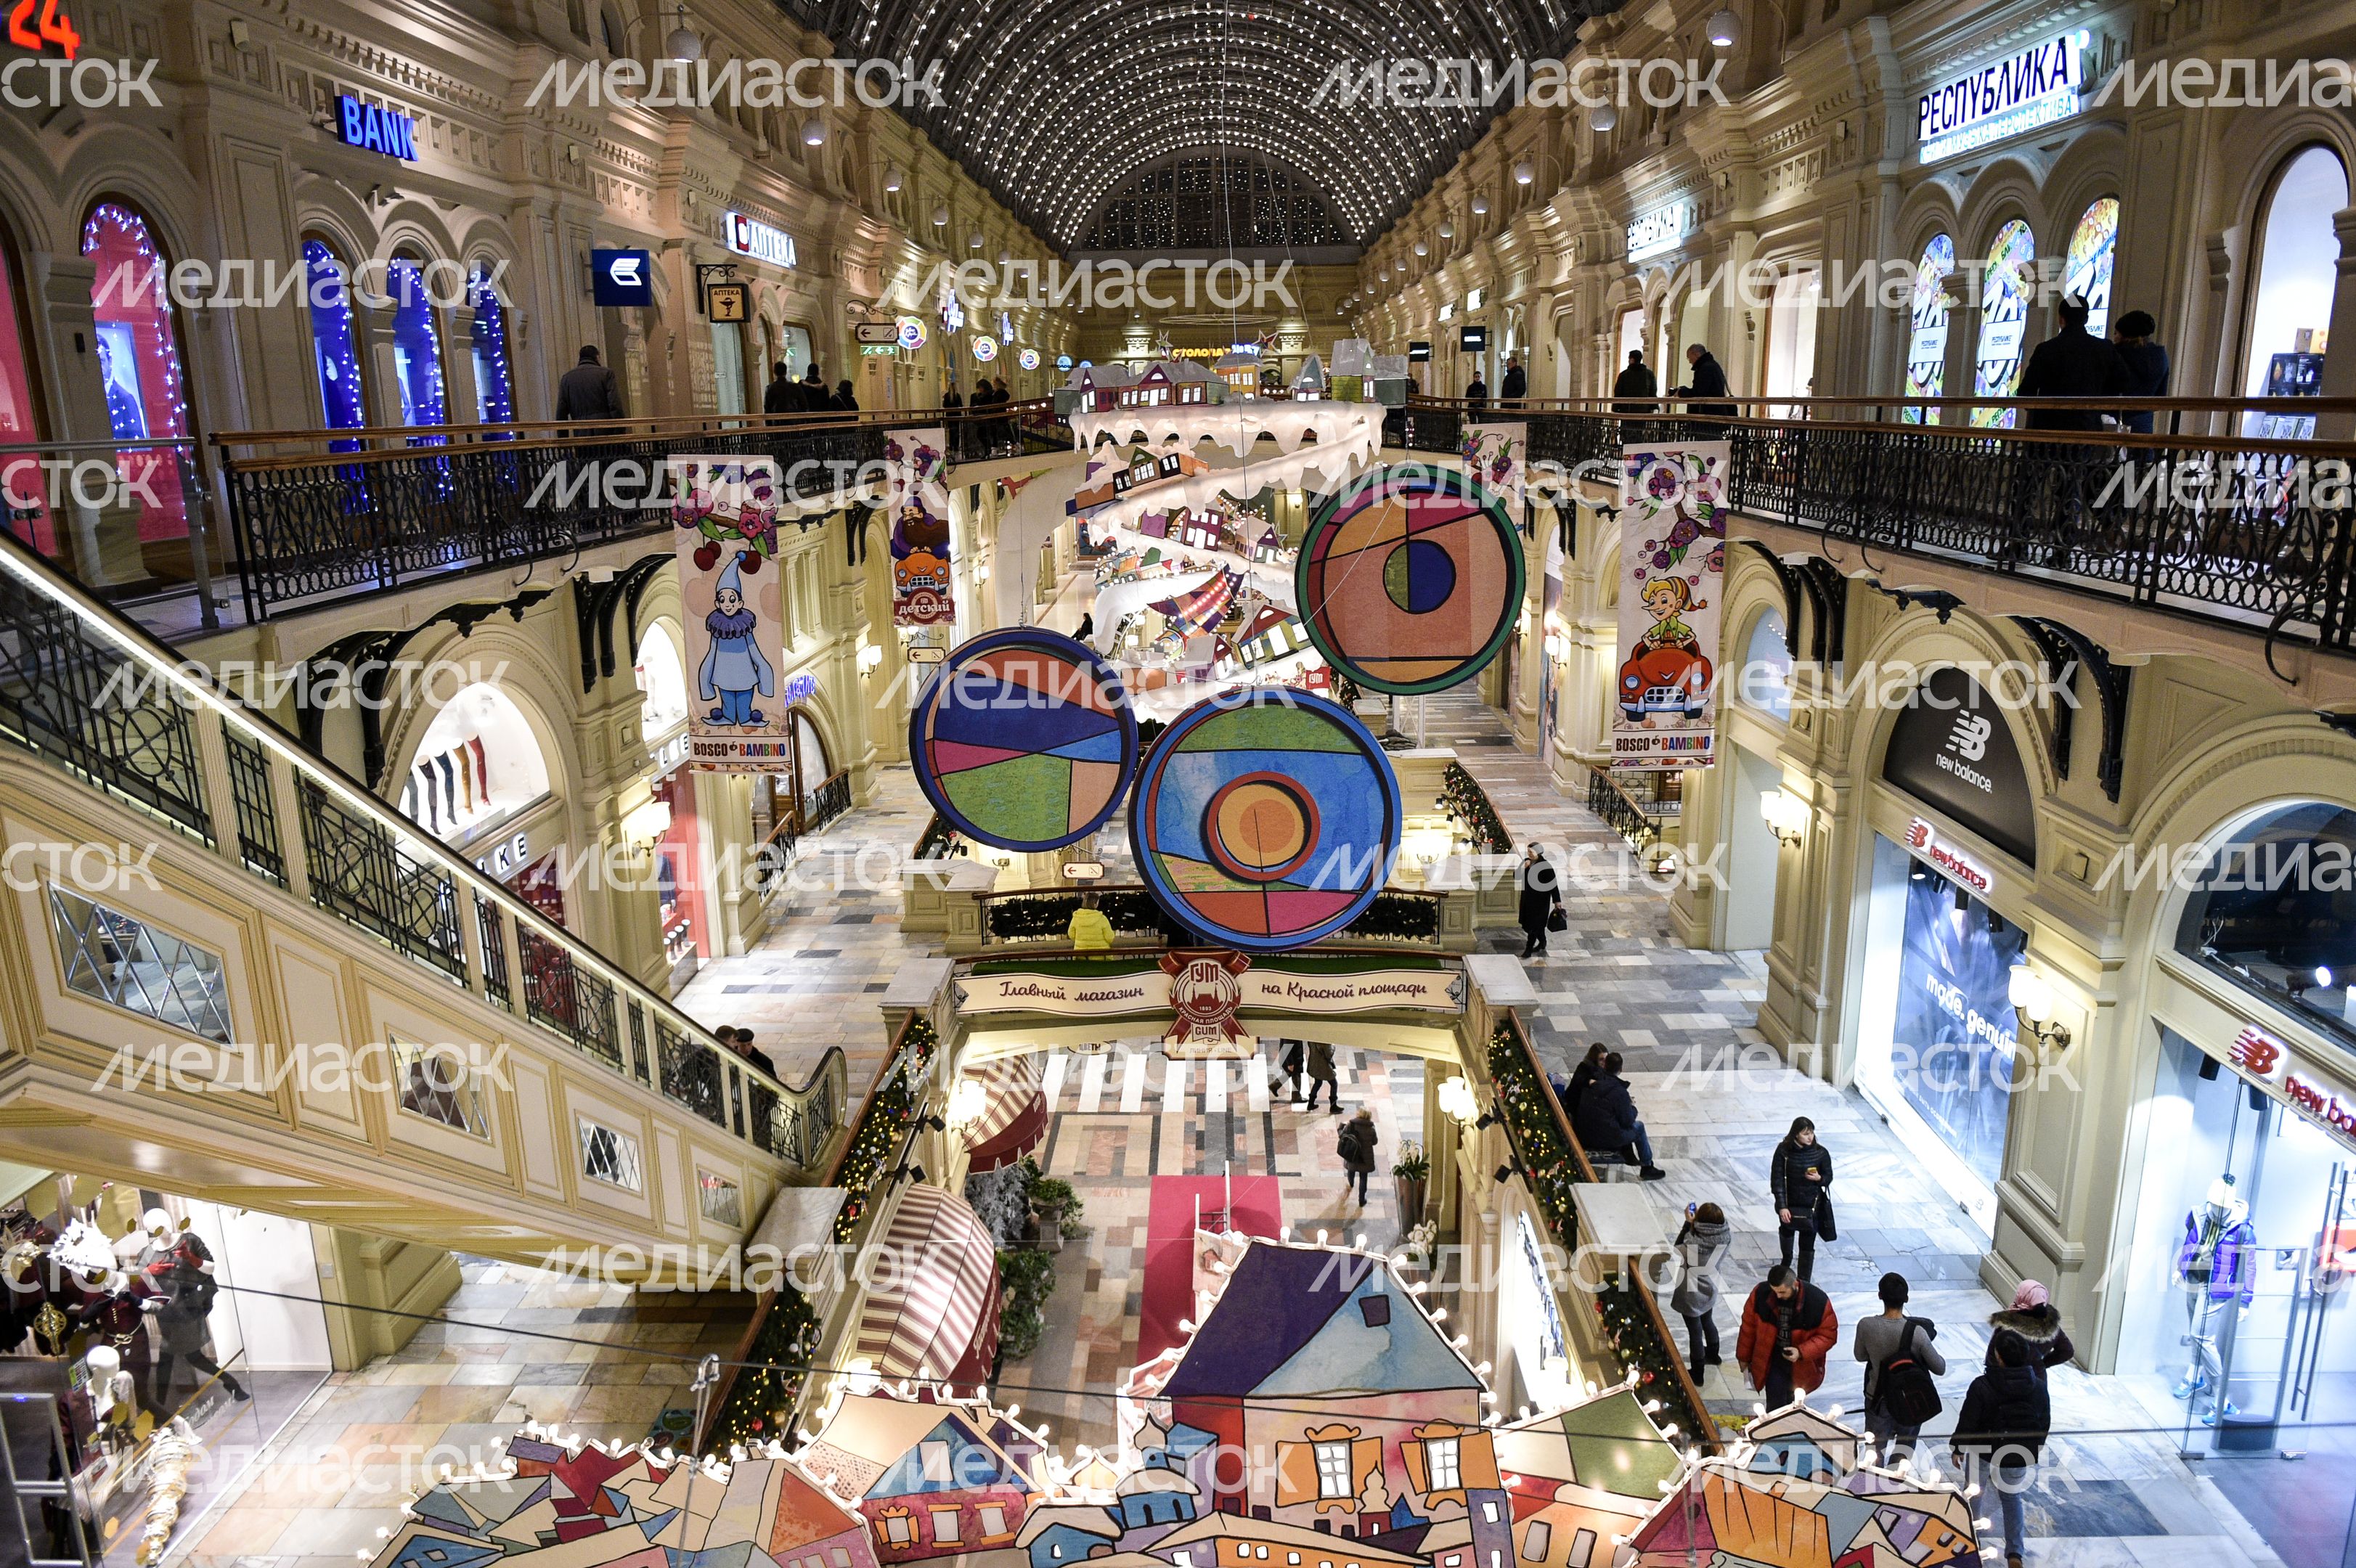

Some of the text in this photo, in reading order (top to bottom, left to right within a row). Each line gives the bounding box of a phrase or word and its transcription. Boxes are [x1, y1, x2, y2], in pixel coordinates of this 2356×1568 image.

[1917, 36, 2069, 140] РЕСПУБЛИКА
[343, 94, 420, 162] BANK
[750, 223, 797, 266] АПТЕКА
[899, 600, 950, 615] детский
[694, 743, 786, 757] BOSCO BAMBINO
[1616, 735, 1711, 752] BOSCO BAMBINO
[1936, 753, 1954, 773] new
[1930, 844, 1987, 890] new balance
[1190, 963, 1219, 983] ГУМ
[999, 981, 1144, 1002] Главный магазин
[1261, 981, 1427, 1003] на Красной площади
[1178, 1006, 1233, 1024] КРАСНАЯ ПЛОЩАДЬ
[1195, 1026, 1218, 1035] GUM
[1965, 1008, 2017, 1062] genuin
[2285, 1075, 2328, 1113] new
